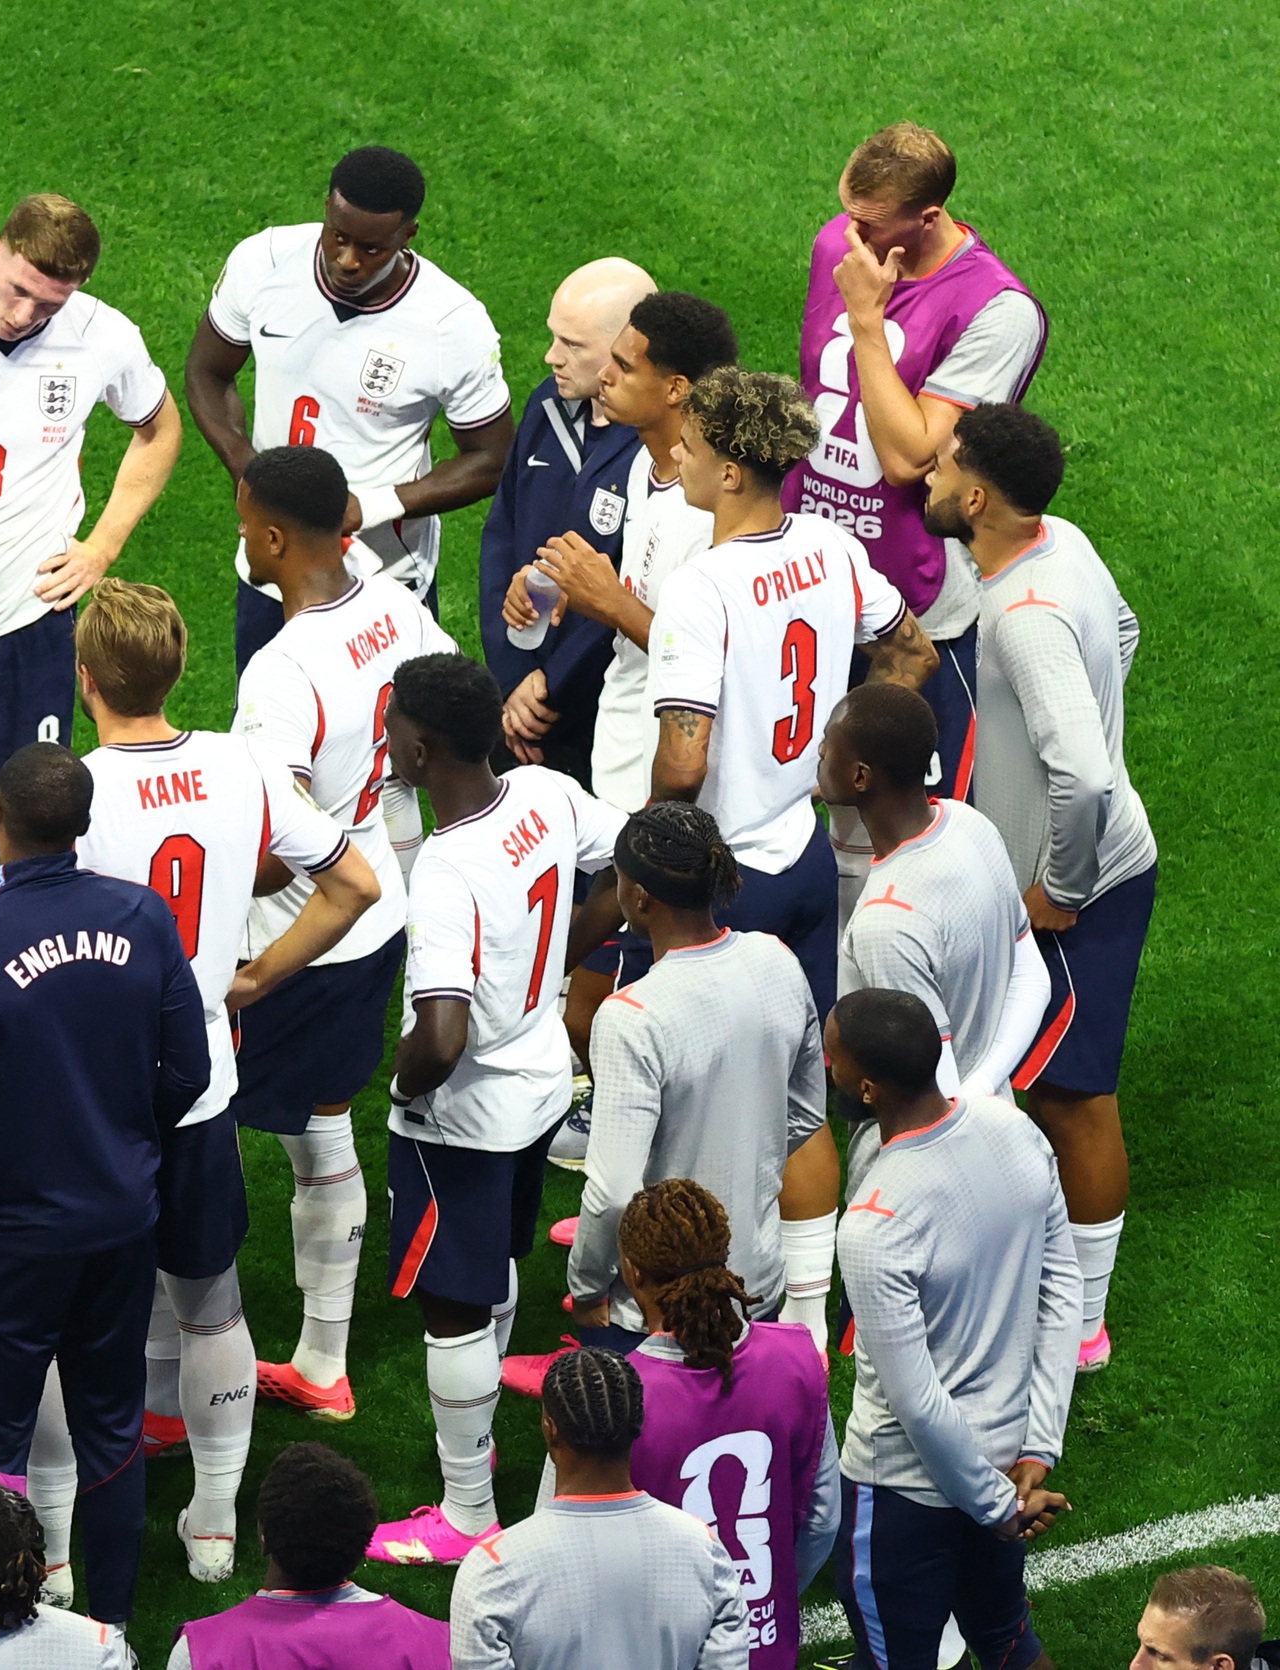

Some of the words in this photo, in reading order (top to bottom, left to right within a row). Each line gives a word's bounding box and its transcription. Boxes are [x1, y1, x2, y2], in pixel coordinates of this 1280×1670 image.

[288, 395, 321, 447] 6
[824, 443, 859, 471] FIFA
[800, 493, 883, 539] 2026
[803, 474, 848, 505] WORLD
[849, 494, 884, 512] CUP
[345, 613, 400, 670] KONSA
[772, 618, 817, 765] 3
[137, 769, 208, 810] KANE
[502, 809, 550, 868] SAKA
[148, 833, 206, 962] 9
[4, 931, 131, 989] ENGLAND
[522, 862, 559, 1019] 7
[347, 1224, 366, 1242] EN
[209, 1385, 249, 1406] ENG
[748, 1619, 777, 1649] 26
